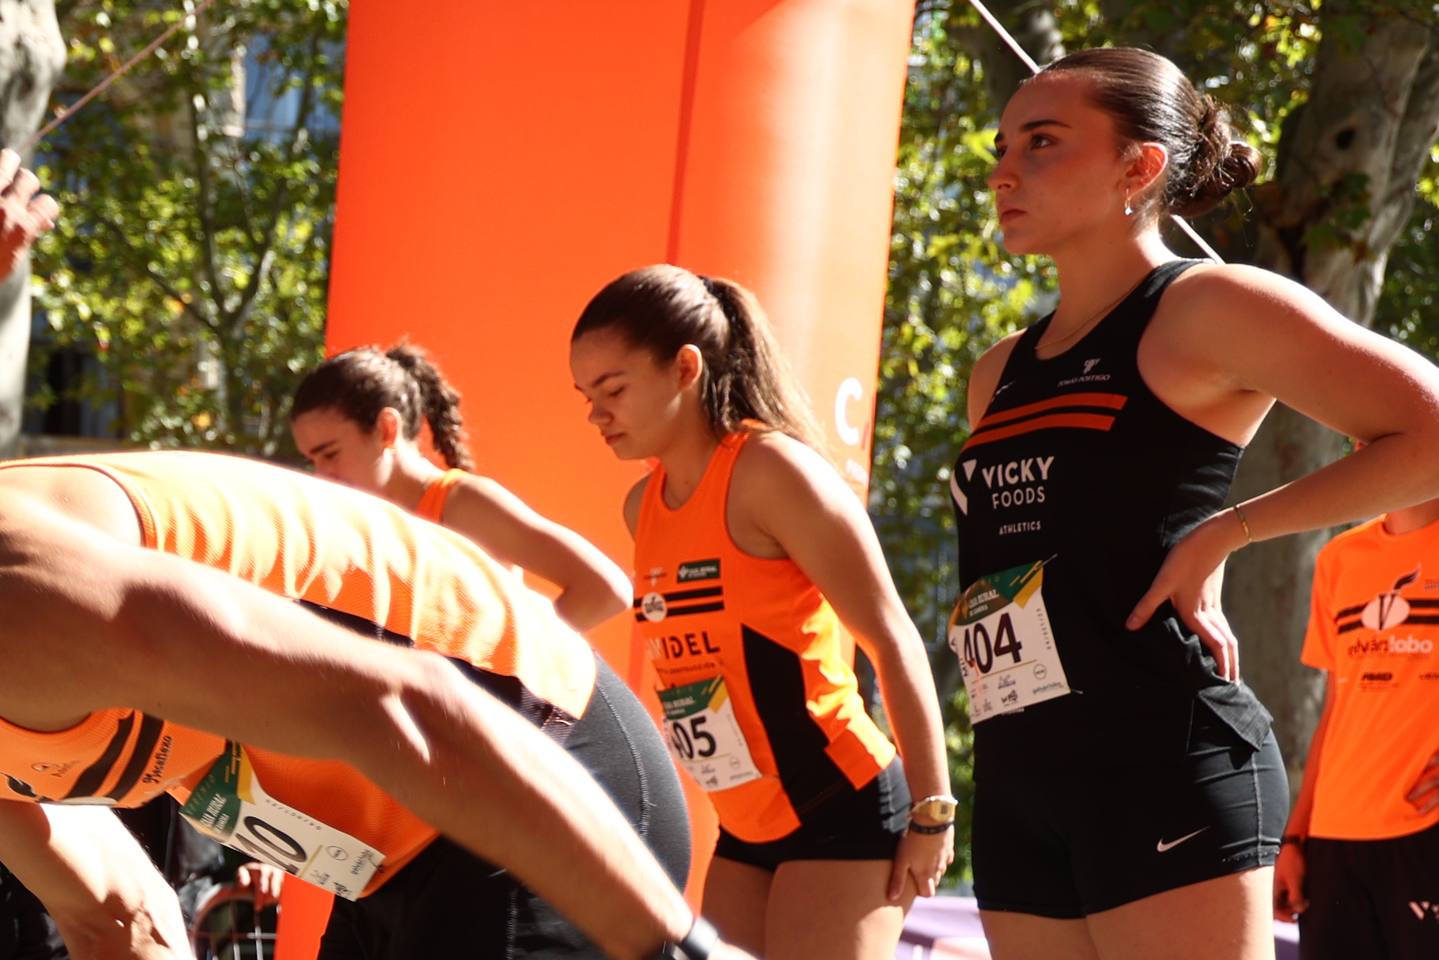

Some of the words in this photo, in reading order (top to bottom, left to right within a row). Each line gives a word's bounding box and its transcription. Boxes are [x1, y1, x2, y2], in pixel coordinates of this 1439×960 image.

[981, 456, 1055, 489] VICKY
[991, 486, 1046, 510] FOODS
[999, 520, 1042, 536] ATHLETICS
[964, 612, 1023, 674] 404
